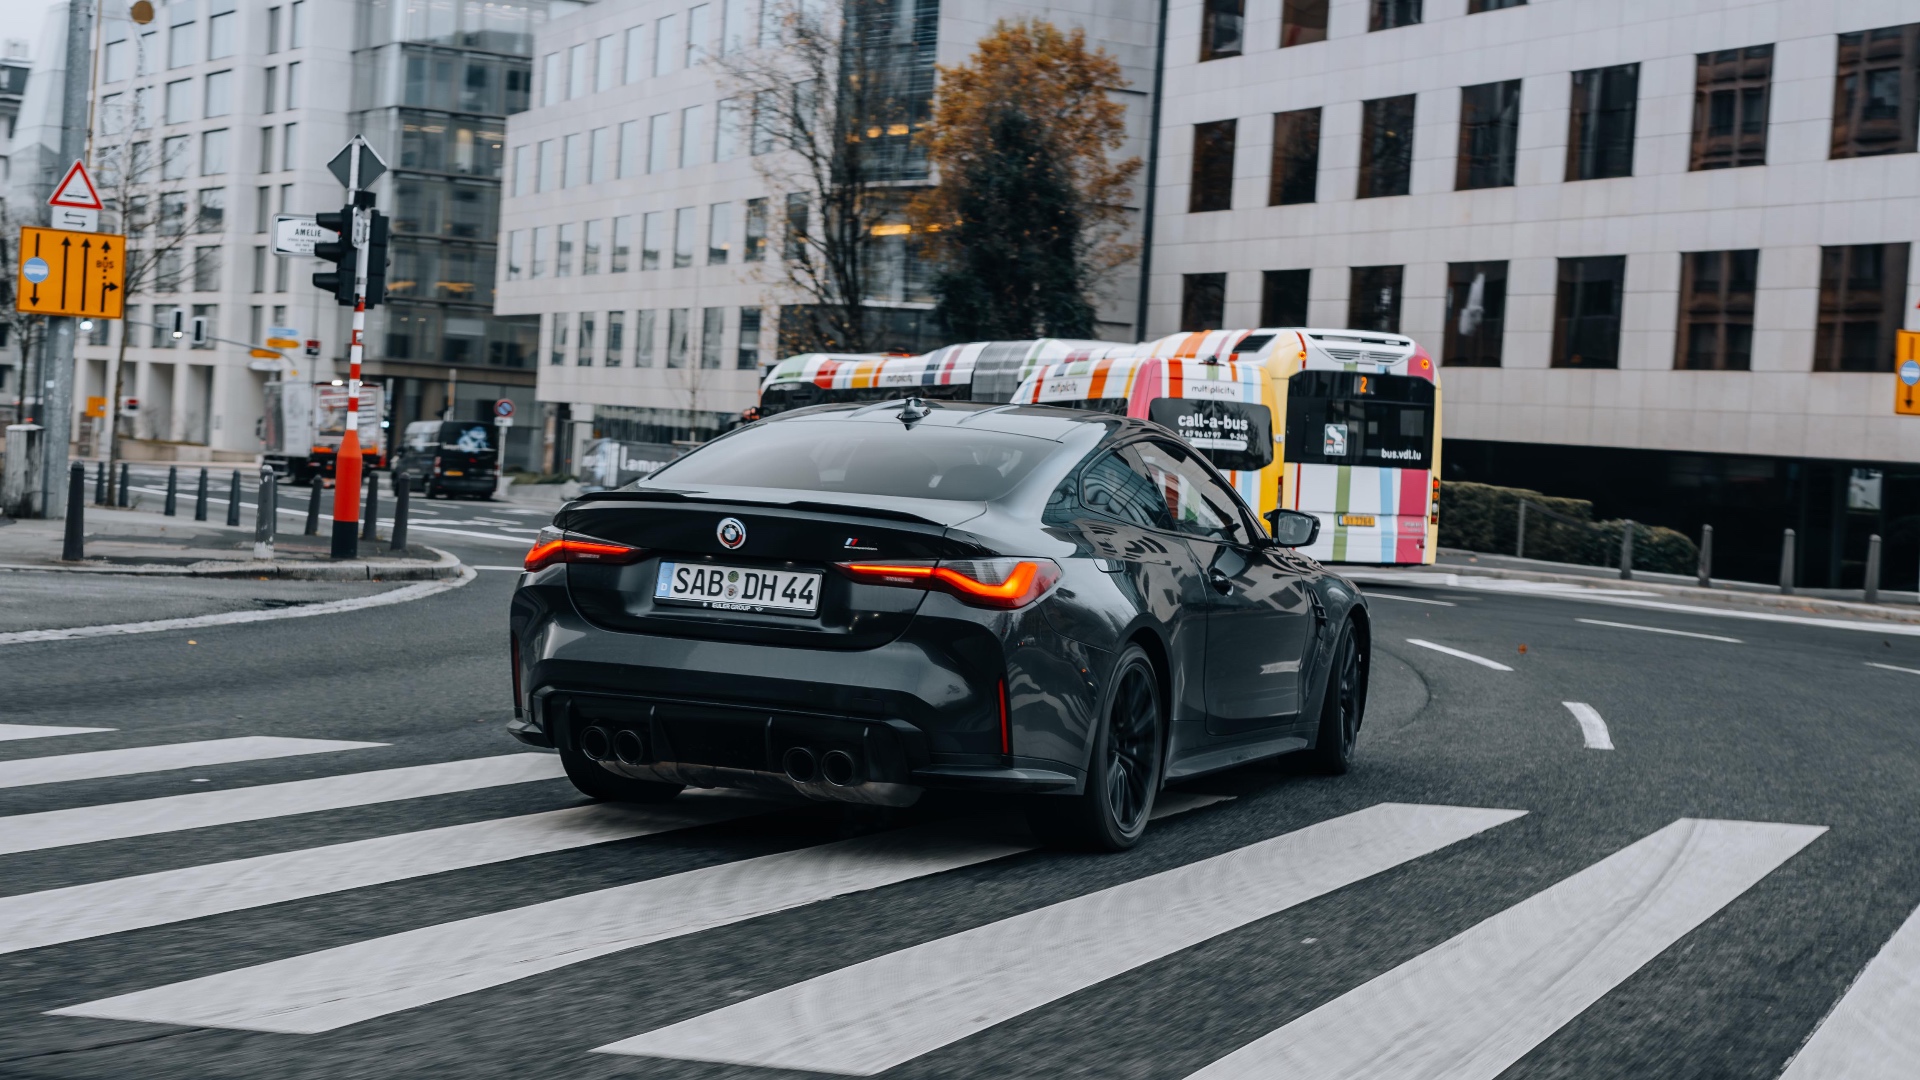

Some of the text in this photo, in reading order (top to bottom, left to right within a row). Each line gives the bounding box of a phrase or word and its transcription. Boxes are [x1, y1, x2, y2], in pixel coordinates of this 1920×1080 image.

[96, 260, 114, 269] BUS
[1360, 376, 1368, 393] 2
[1178, 413, 1248, 431] call-a-bus
[1381, 448, 1422, 460] bus.vdl.lu
[660, 582, 668, 591] D
[673, 567, 815, 605] SAB DH 44
[711, 602, 751, 612] EULER GROUP
